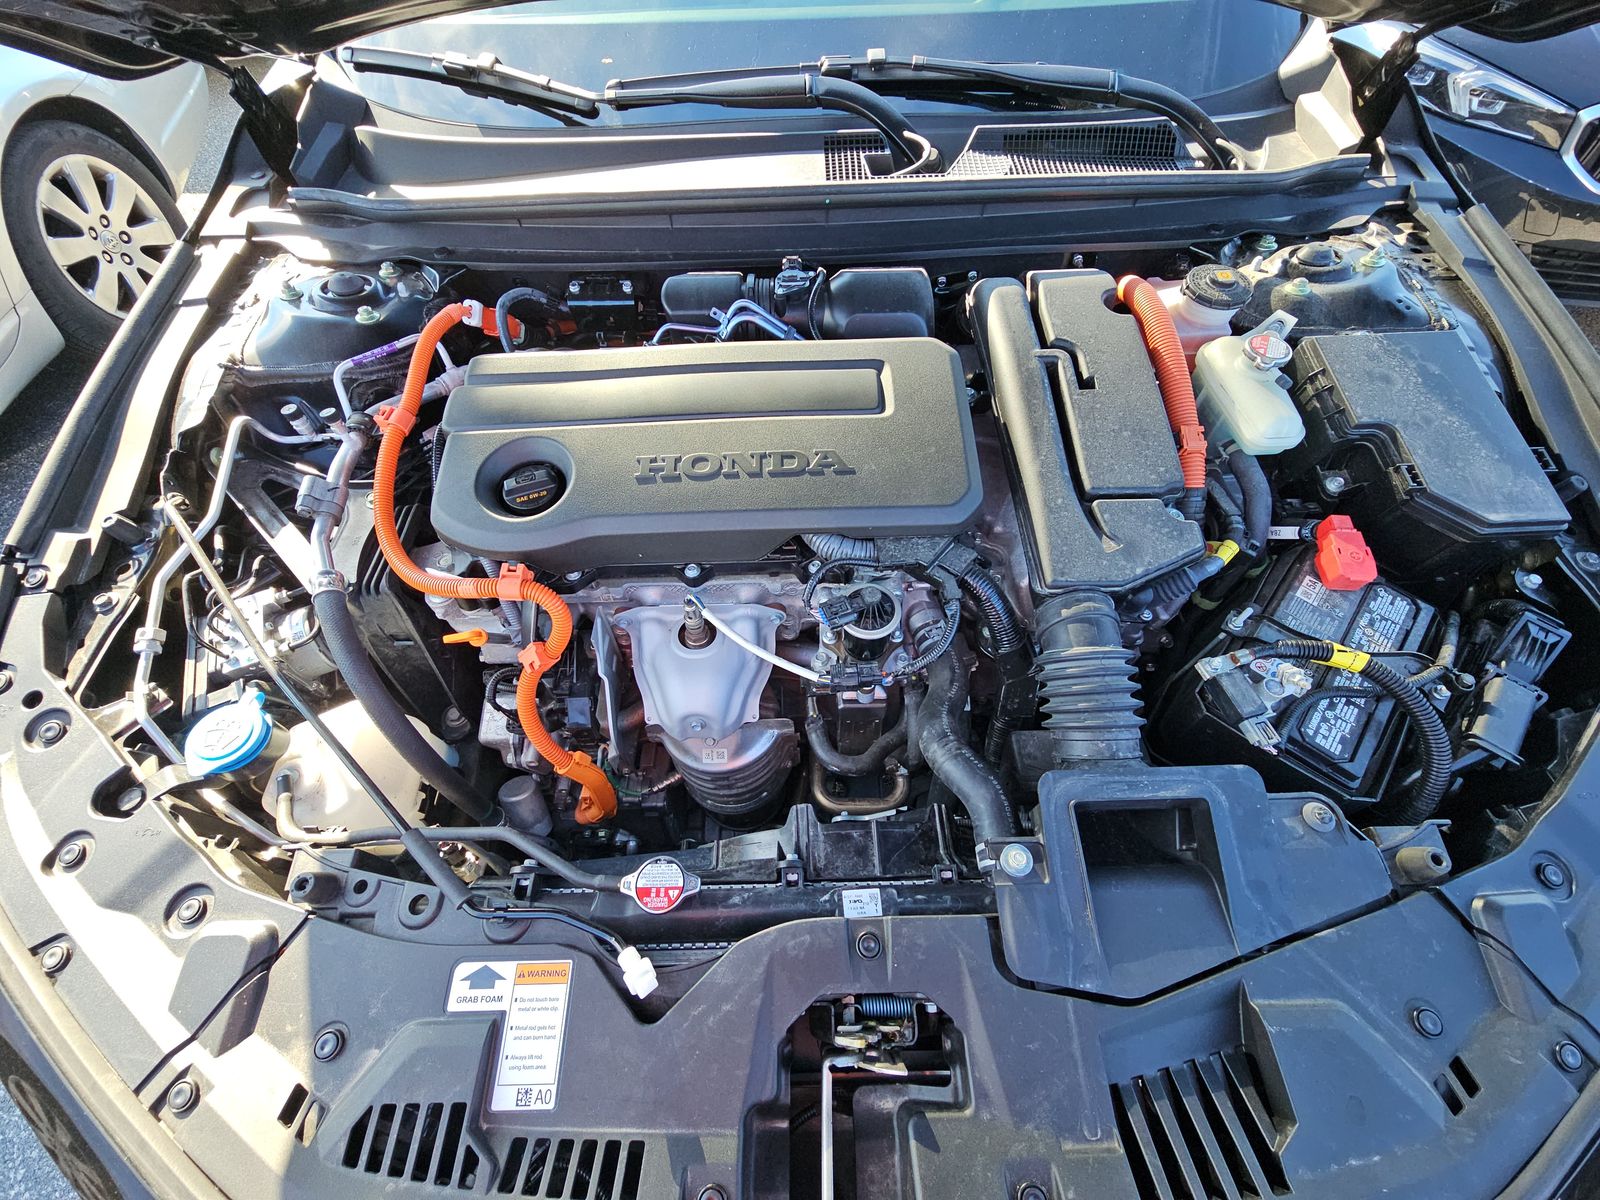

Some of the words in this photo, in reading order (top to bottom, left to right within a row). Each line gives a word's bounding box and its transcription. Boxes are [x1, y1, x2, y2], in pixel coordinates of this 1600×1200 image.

[634, 449, 857, 484] HONDA
[515, 495, 529, 503] SAE
[529, 490, 548, 500] 0W-20
[527, 969, 567, 978] WARNING
[456, 995, 479, 1004] GRAB
[480, 995, 503, 1003] FOAM
